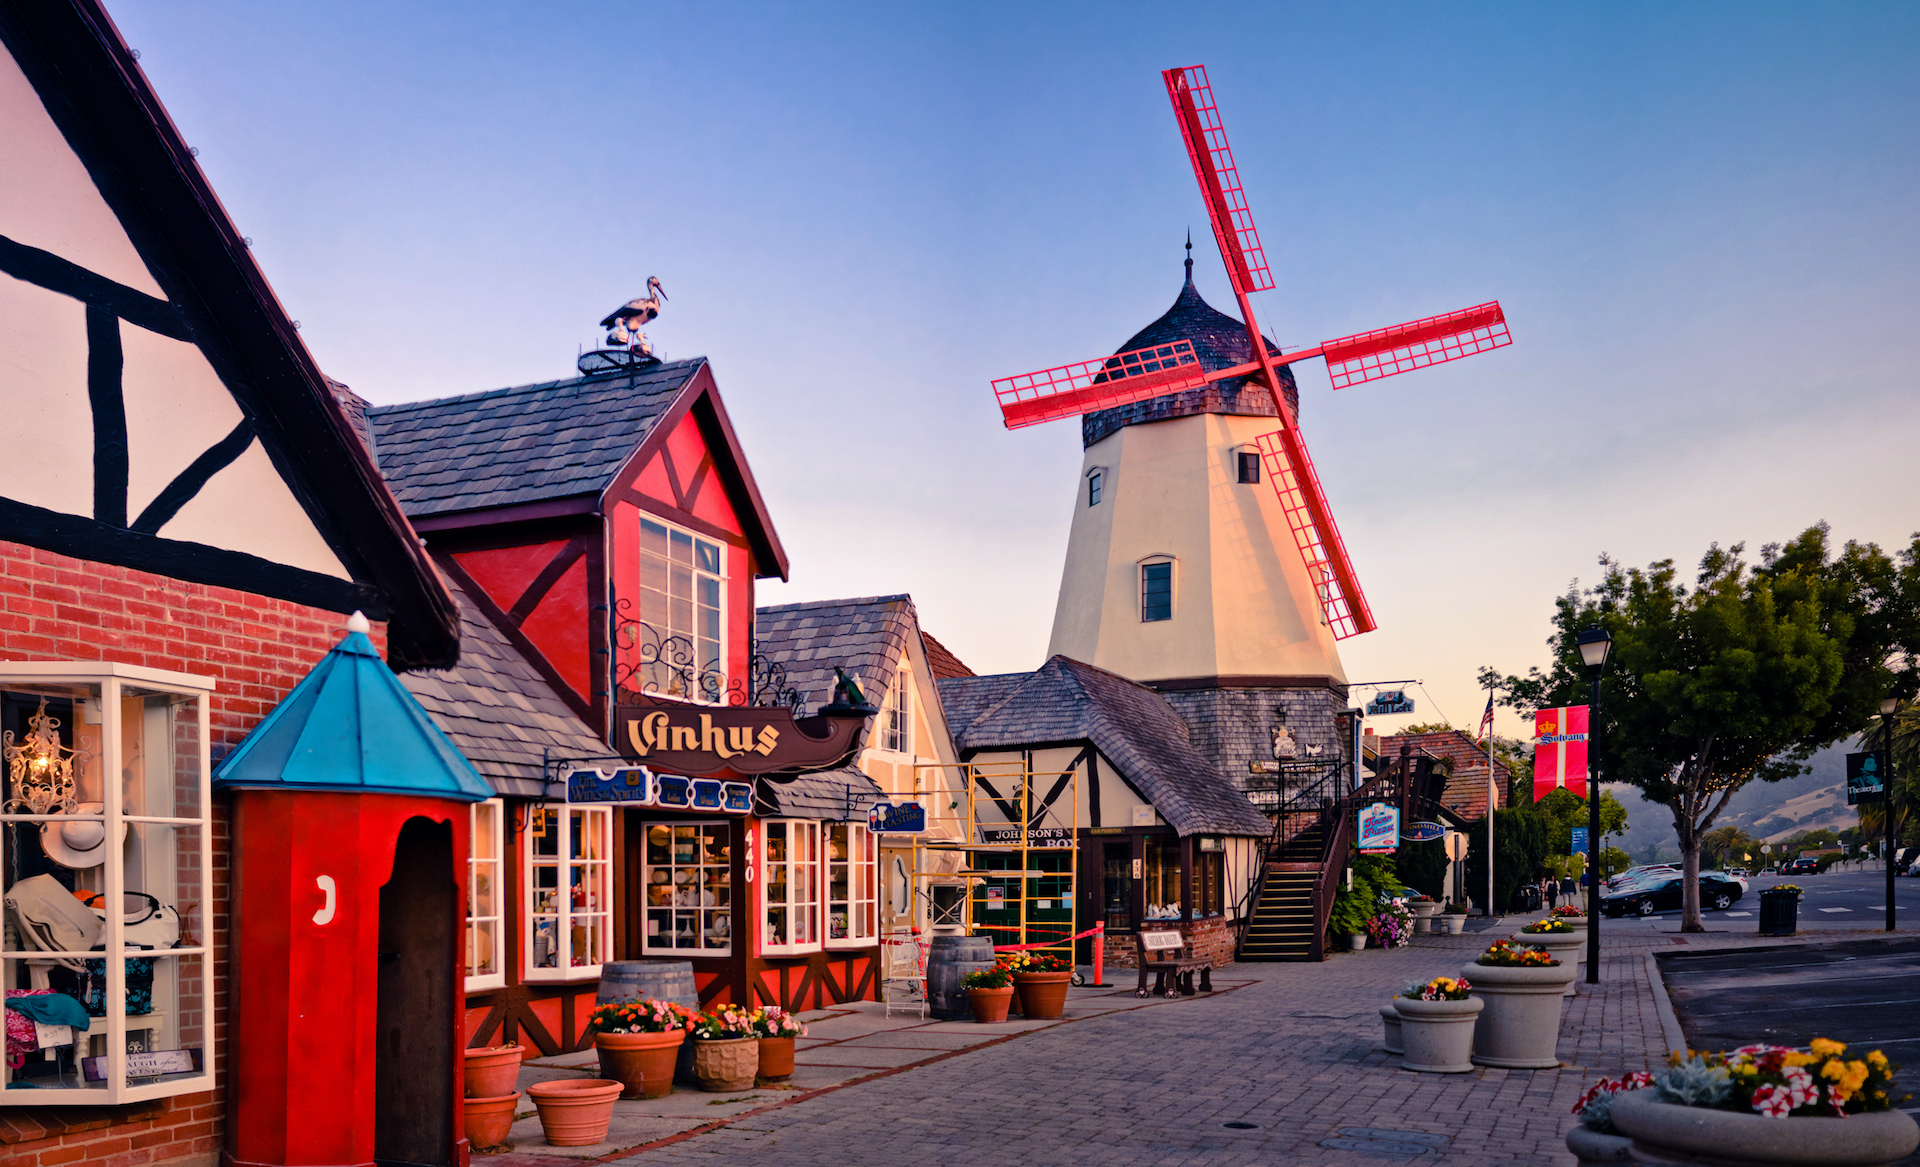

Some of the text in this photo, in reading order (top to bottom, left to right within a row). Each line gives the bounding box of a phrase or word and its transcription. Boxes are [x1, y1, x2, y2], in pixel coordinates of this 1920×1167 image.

[628, 711, 780, 759] Vinhus
[1539, 732, 1585, 746] Solvang
[578, 775, 598, 788] Fine
[570, 785, 602, 801] Wines
[611, 783, 644, 800] Spirits
[885, 804, 911, 819] WINE
[885, 811, 922, 828] TASTING
[1364, 815, 1393, 829] Tower
[995, 829, 1064, 839] JOHSON'S
[1363, 824, 1395, 839] Pizza
[744, 828, 755, 883] 440
[127, 1060, 157, 1068] AUGH
